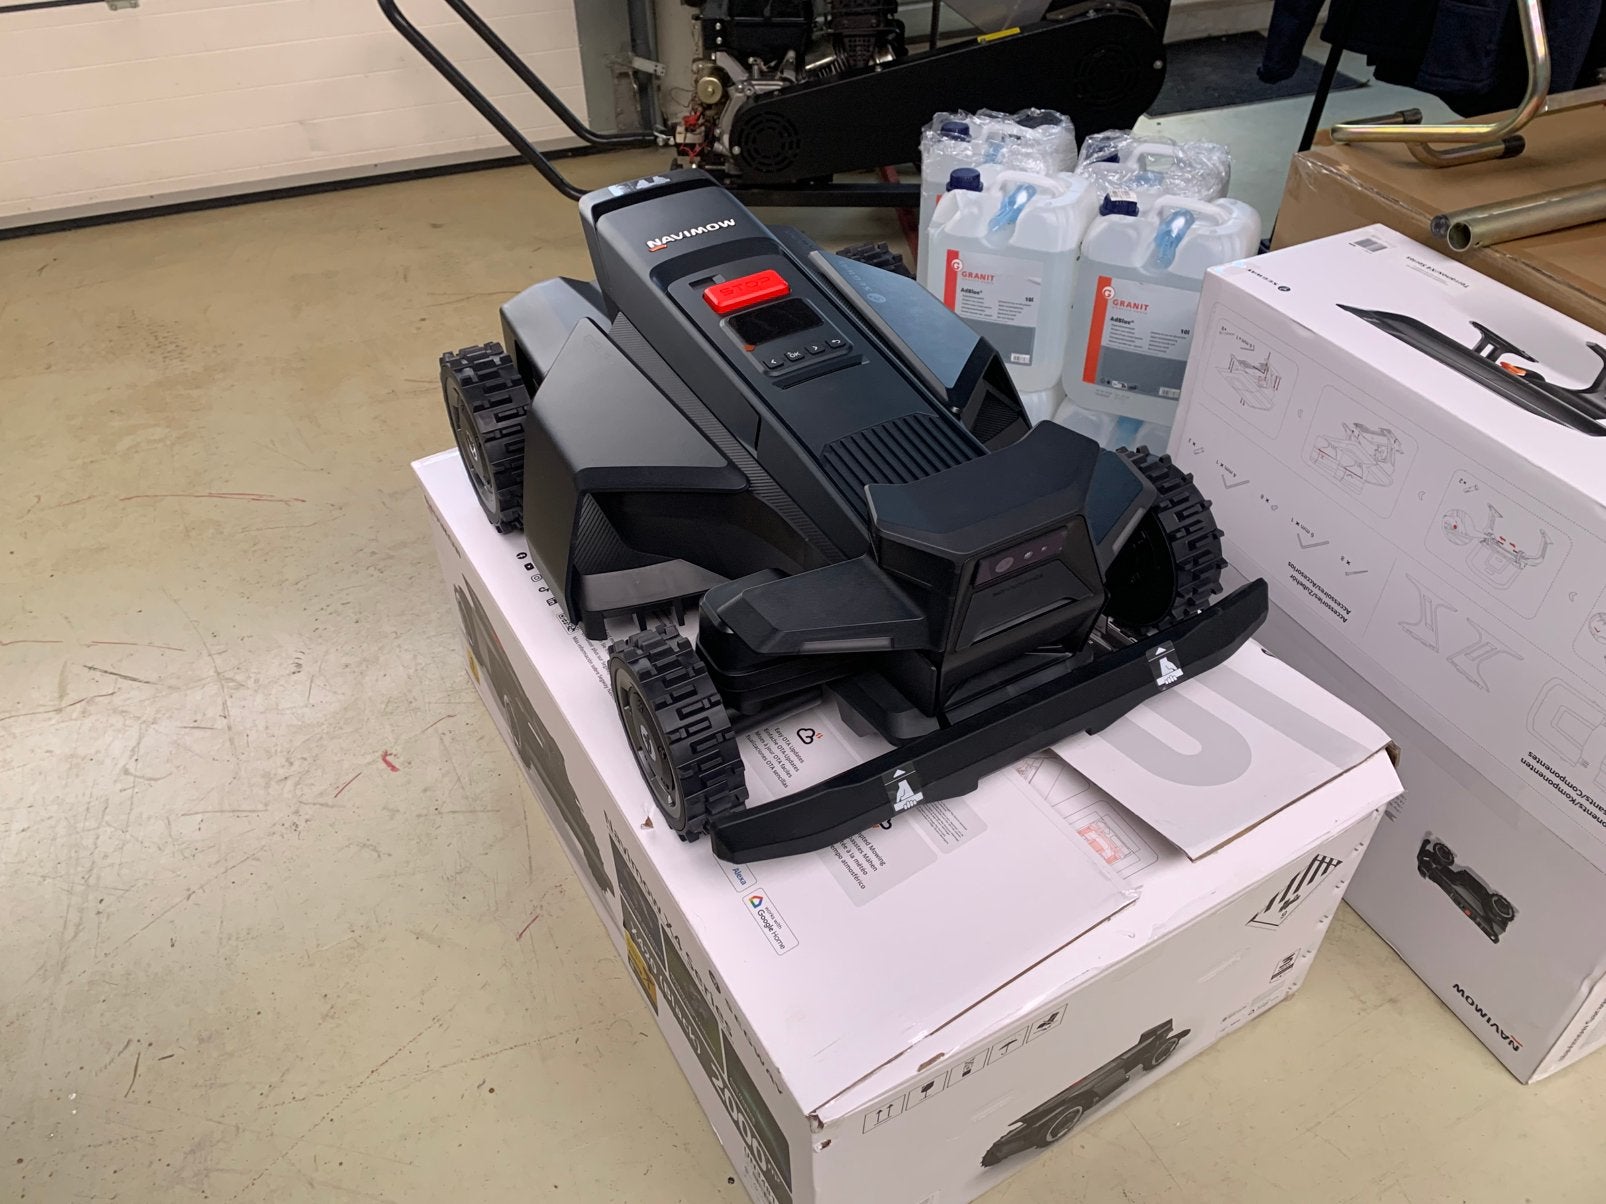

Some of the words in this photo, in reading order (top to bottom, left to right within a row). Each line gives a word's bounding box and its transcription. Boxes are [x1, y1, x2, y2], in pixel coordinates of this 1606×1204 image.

[646, 218, 736, 250] NAVIMOW
[719, 276, 771, 297] STOP
[961, 270, 995, 282] GRANIT
[1112, 299, 1149, 311] GRANIT
[782, 736, 792, 747] OTA
[790, 745, 805, 764] Updates
[765, 760, 776, 770] OTA
[773, 769, 789, 789] sencillas
[773, 754, 782, 765] OTA
[780, 763, 793, 779] faciles
[853, 858, 868, 875] météo
[862, 853, 878, 872] Mähen
[869, 845, 886, 867] Mowing
[732, 867, 747, 886] Alexa
[841, 859, 866, 889] atmosférico
[757, 909, 775, 932] Google
[772, 930, 786, 950] Home
[774, 918, 782, 930] with
[1452, 983, 1522, 1052] NAVIMOW
[709, 1061, 767, 1172] 2000
